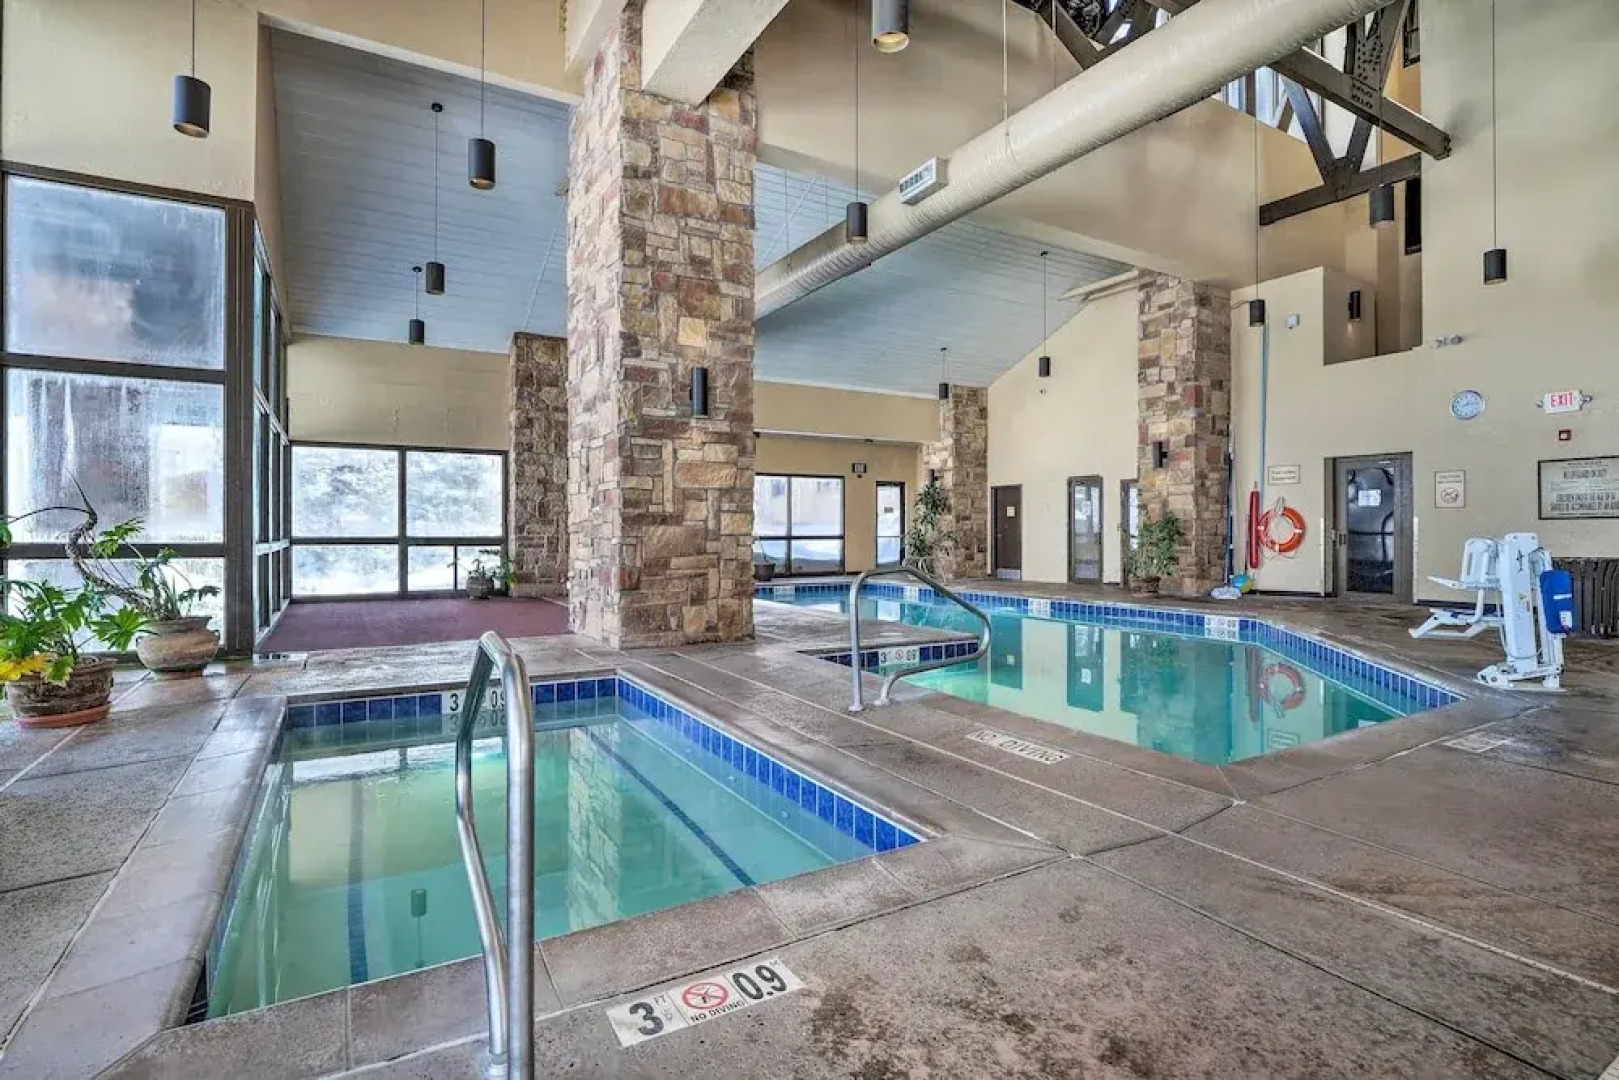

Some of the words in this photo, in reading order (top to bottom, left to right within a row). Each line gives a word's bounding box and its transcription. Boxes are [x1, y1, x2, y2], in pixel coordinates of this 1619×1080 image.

[1551, 392, 1573, 408] EXIT
[449, 692, 460, 712] 3
[629, 1002, 665, 1036] 3
[690, 1012, 707, 1023] NO
[708, 1000, 746, 1019] DIVING
